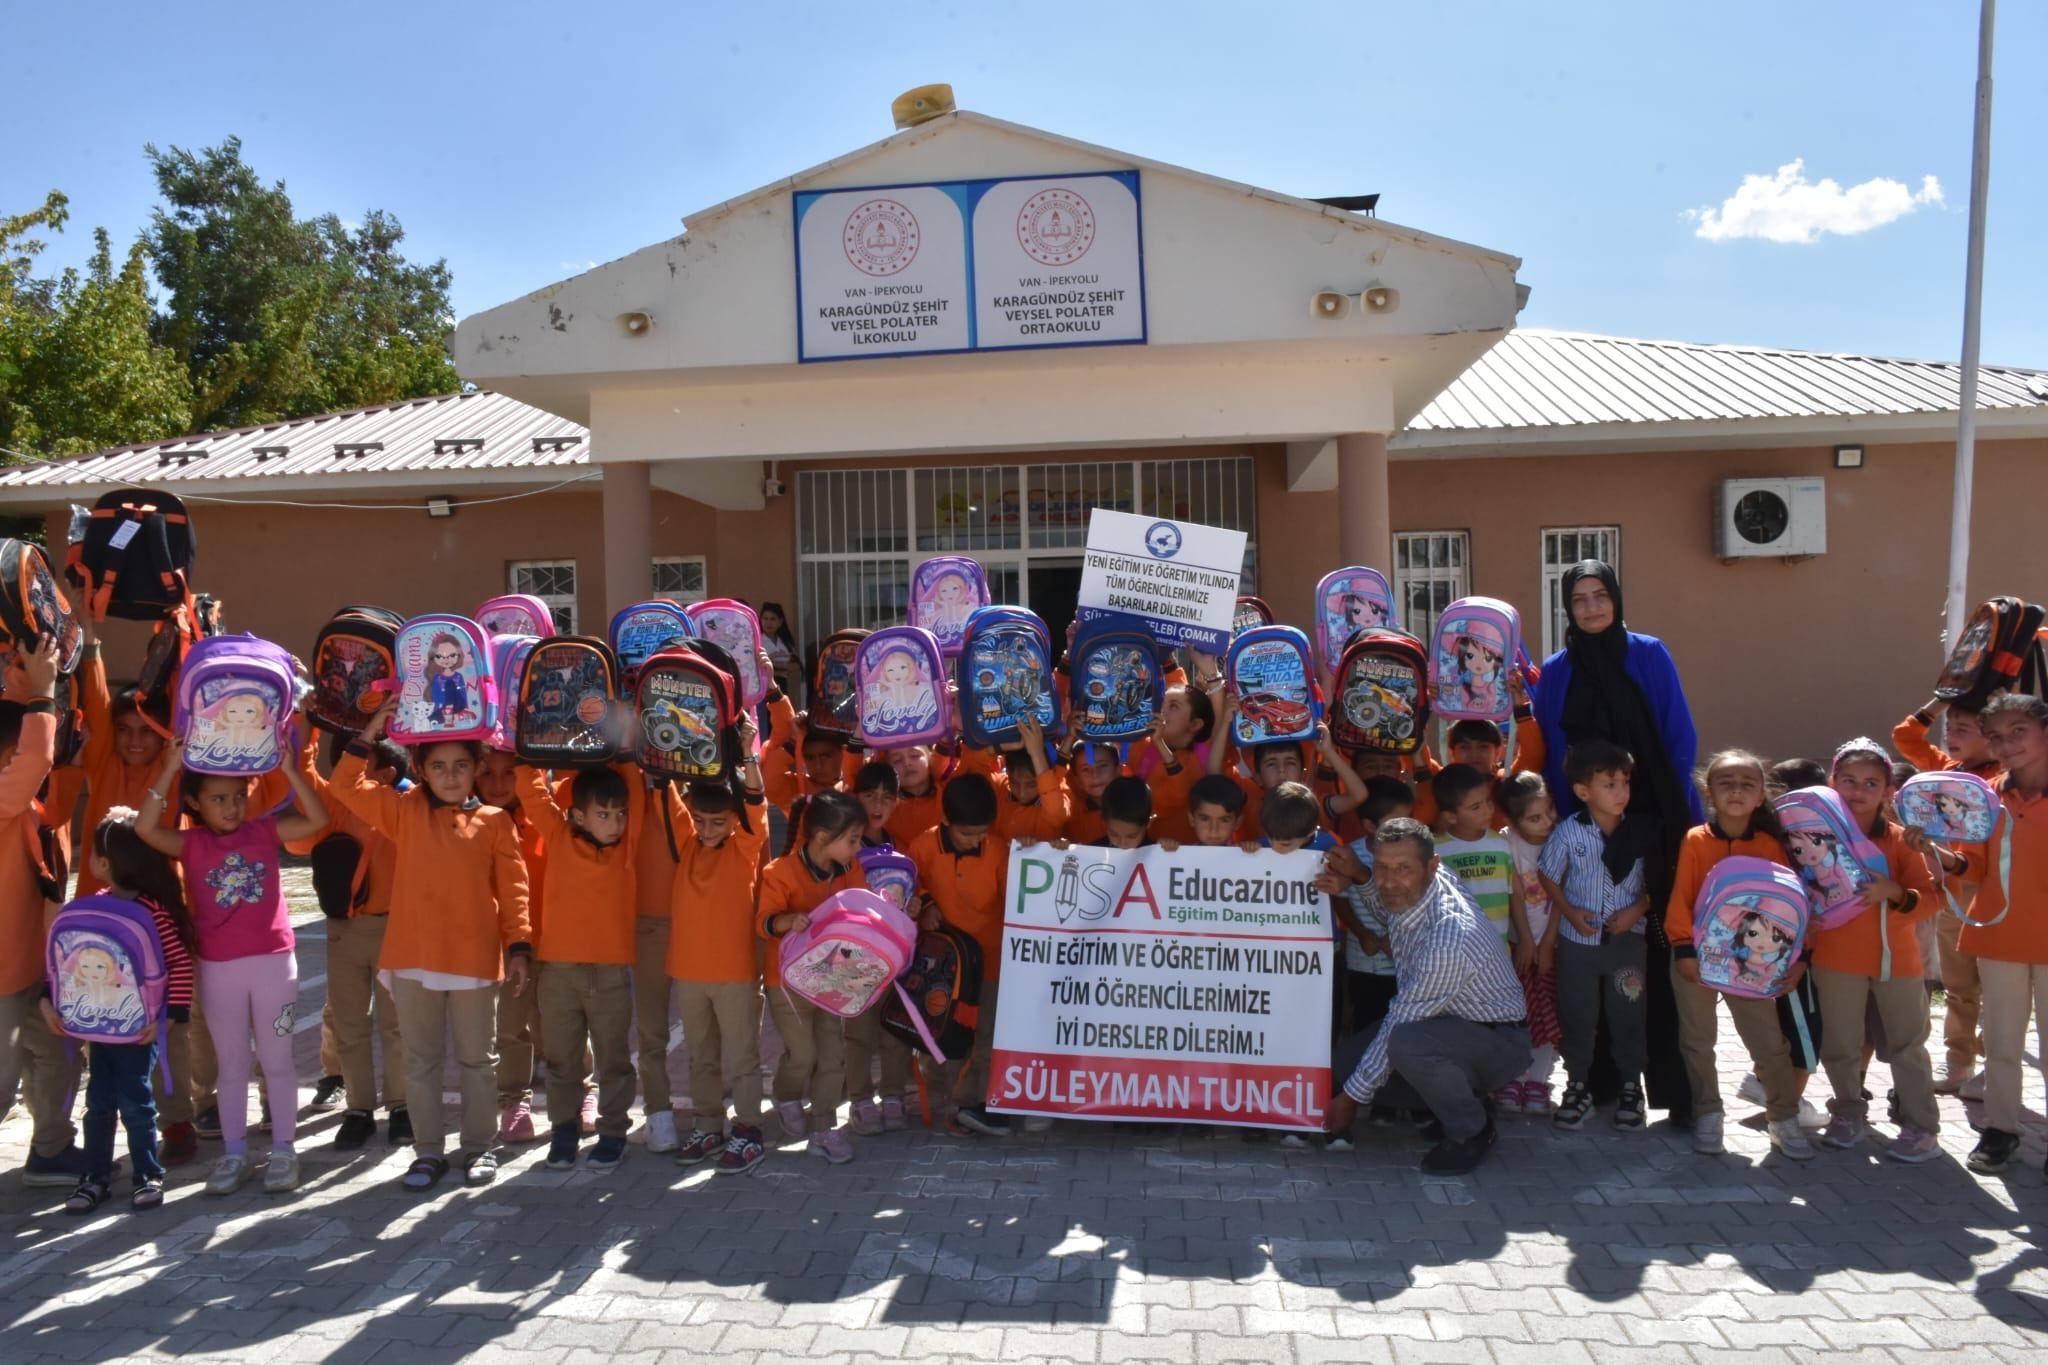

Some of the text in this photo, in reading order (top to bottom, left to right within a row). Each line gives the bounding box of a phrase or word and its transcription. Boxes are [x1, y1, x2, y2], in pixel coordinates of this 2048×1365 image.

[845, 288, 866, 298] VAN
[874, 284, 923, 296] İPEKYOLU
[1019, 278, 1041, 287] VAN
[1049, 274, 1099, 286] İPEKYOLU
[819, 298, 949, 318] KARAGÜNDÜZ ŞEHİT
[994, 288, 1125, 308] KARAGÜNDÜZ ŞEHİT
[831, 315, 938, 332] VEYSEL POLATER
[1005, 305, 1114, 321] VEYSEL POLATER
[853, 330, 917, 345] İLKOKULU
[1020, 320, 1101, 335] ORTAOKULU
[1087, 554, 1235, 591] YENİ EĞİTİM VE ÖĞRETİM YILINDA
[1106, 573, 1209, 605] TÜM ÖĞRENCİLERİMİZE
[1108, 593, 1159, 613] BAŞARILAR
[1145, 620, 1177, 637] ELEBİ
[1178, 626, 1218, 644] ÇOMAK
[1238, 659, 1302, 677] SPEED
[650, 675, 712, 699] MONSTER
[543, 689, 561, 707] 23
[863, 688, 938, 734] Lovely
[187, 731, 275, 769] Lovely
[1485, 855, 1496, 865] ON
[1169, 867, 1320, 906] Educazione
[1168, 906, 1321, 927] Eğitim Danışmanlık
[1010, 935, 1322, 975] YENİ EĞİTİM VE ÖĞRETİM YILINDA
[1050, 975, 1271, 1015] TÜM ÖĞRENCİLERİMİZE
[59, 991, 145, 1033] Lovely
[1056, 1015, 1265, 1057] İYİ DERSLER DİLERİM.!
[1003, 1059, 1324, 1117] SÜLEYMAN TUNCİL
